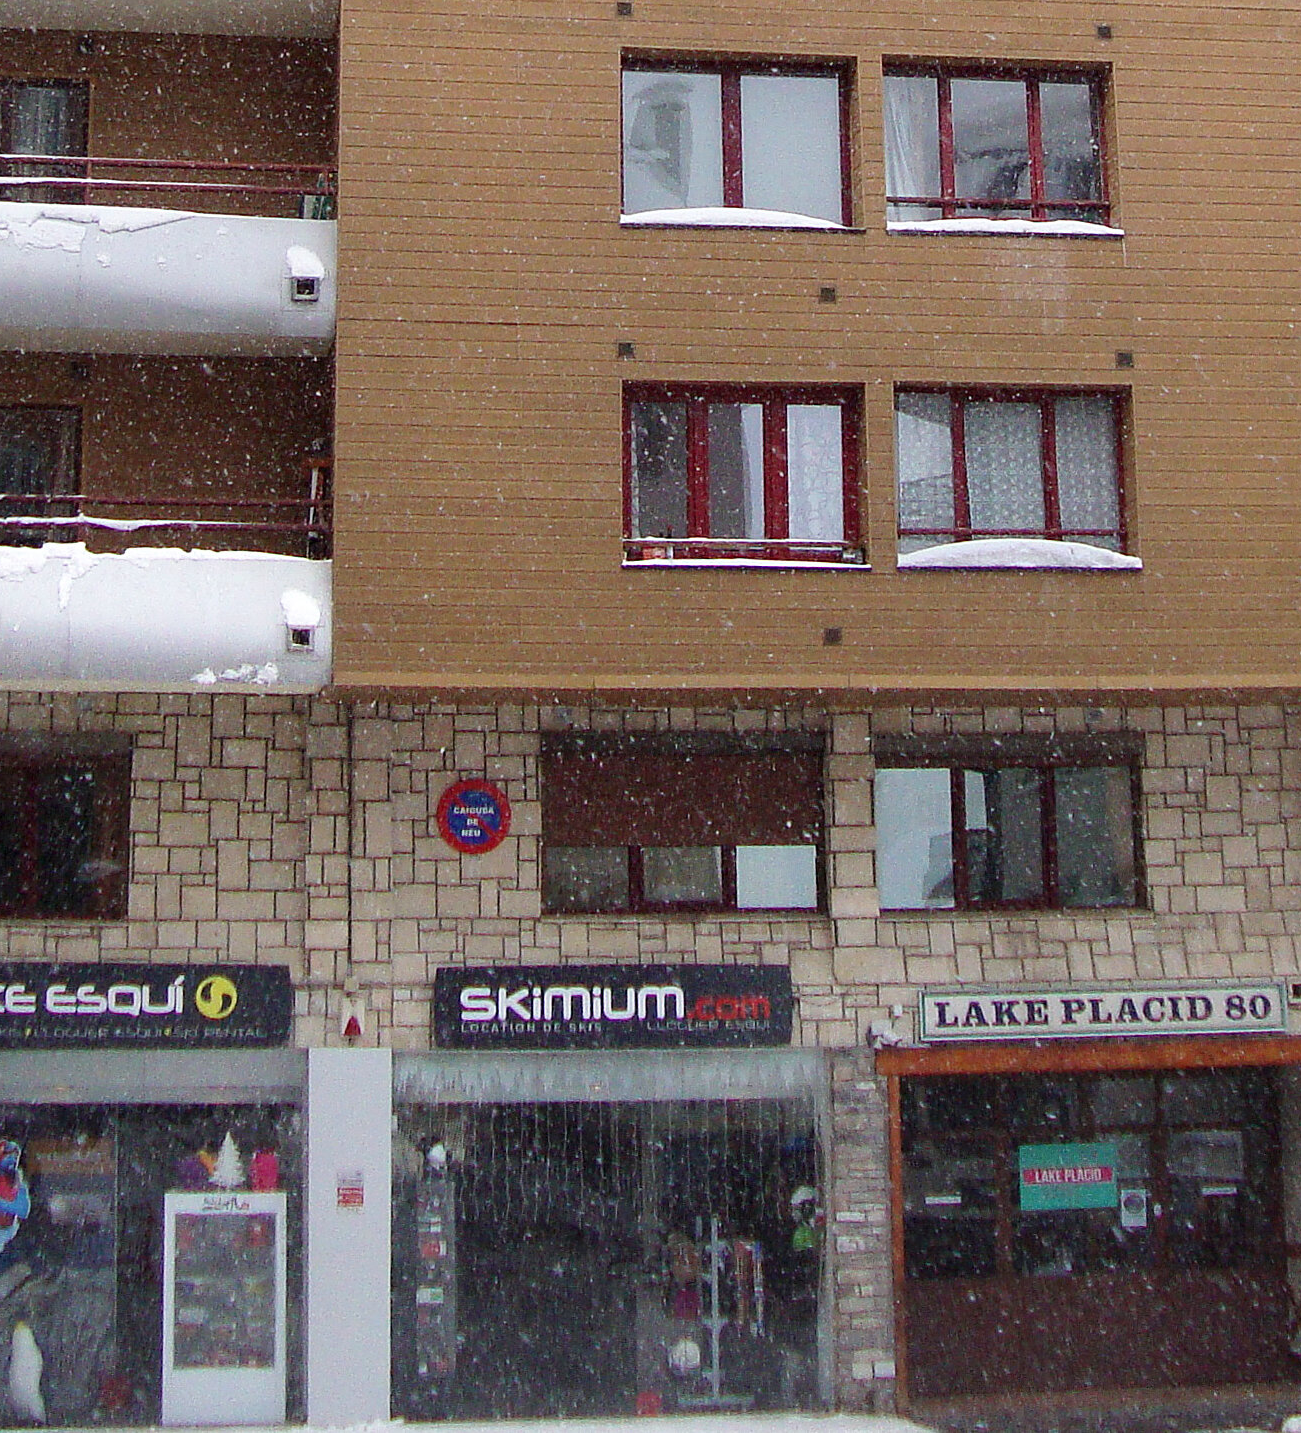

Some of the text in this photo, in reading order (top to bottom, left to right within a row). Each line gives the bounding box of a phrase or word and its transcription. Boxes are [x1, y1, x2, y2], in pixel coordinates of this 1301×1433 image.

[467, 818, 478, 826] DE
[46, 974, 185, 1016] ESQUÍ
[934, 994, 1272, 1028] LAKE PLACID 80
[461, 1021, 536, 1033] LOCATION
[543, 1021, 561, 1033] DE
[1035, 1168, 1102, 1183] LAKE PLACID
